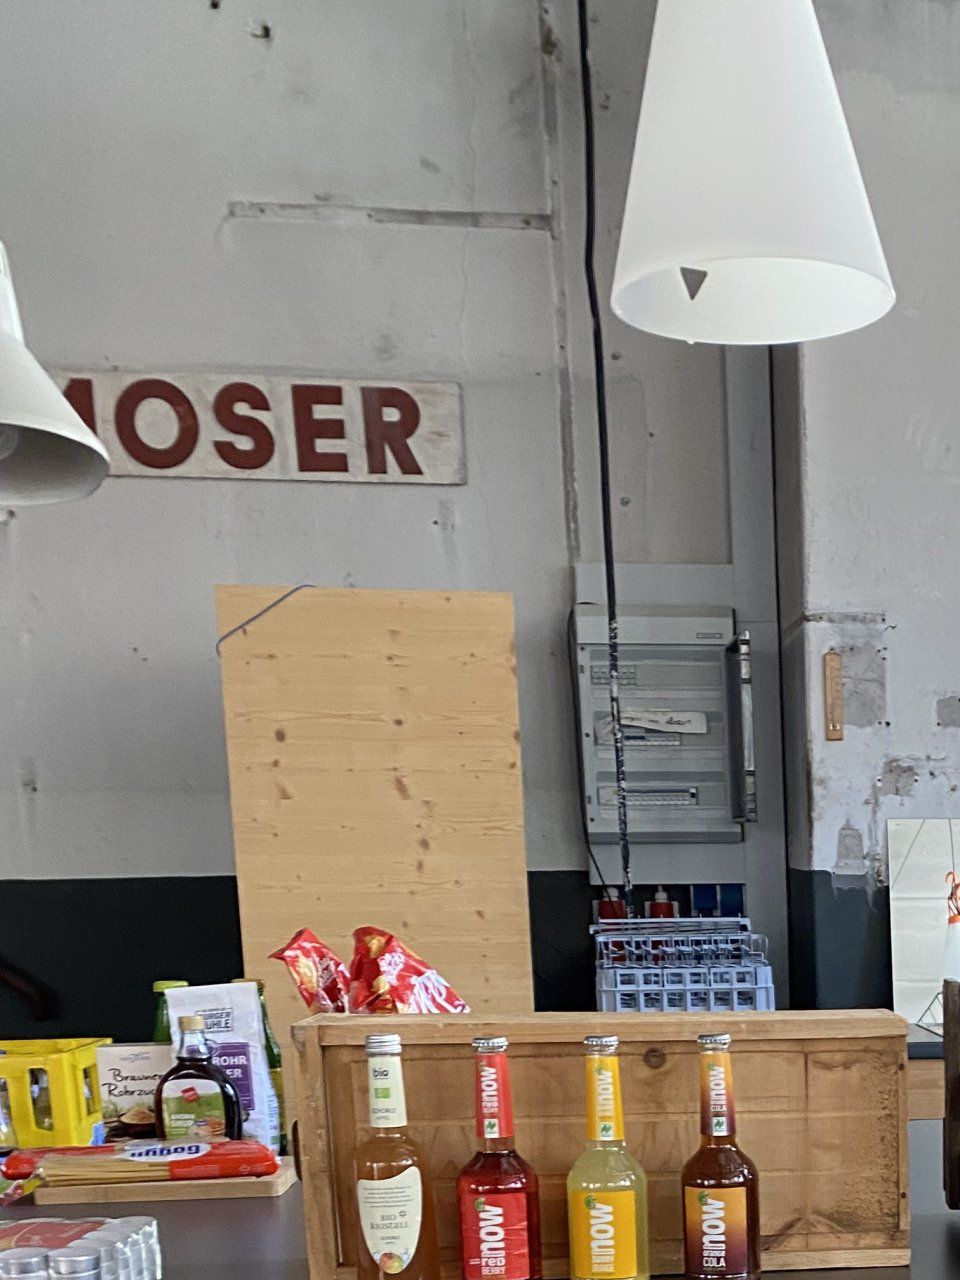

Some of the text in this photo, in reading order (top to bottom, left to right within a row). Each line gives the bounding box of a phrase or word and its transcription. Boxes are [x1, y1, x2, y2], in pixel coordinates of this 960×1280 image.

[478, 1204, 505, 1256] now
[589, 1202, 615, 1256] now
[701, 1198, 726, 1249] now
[702, 1257, 726, 1267] COLA
